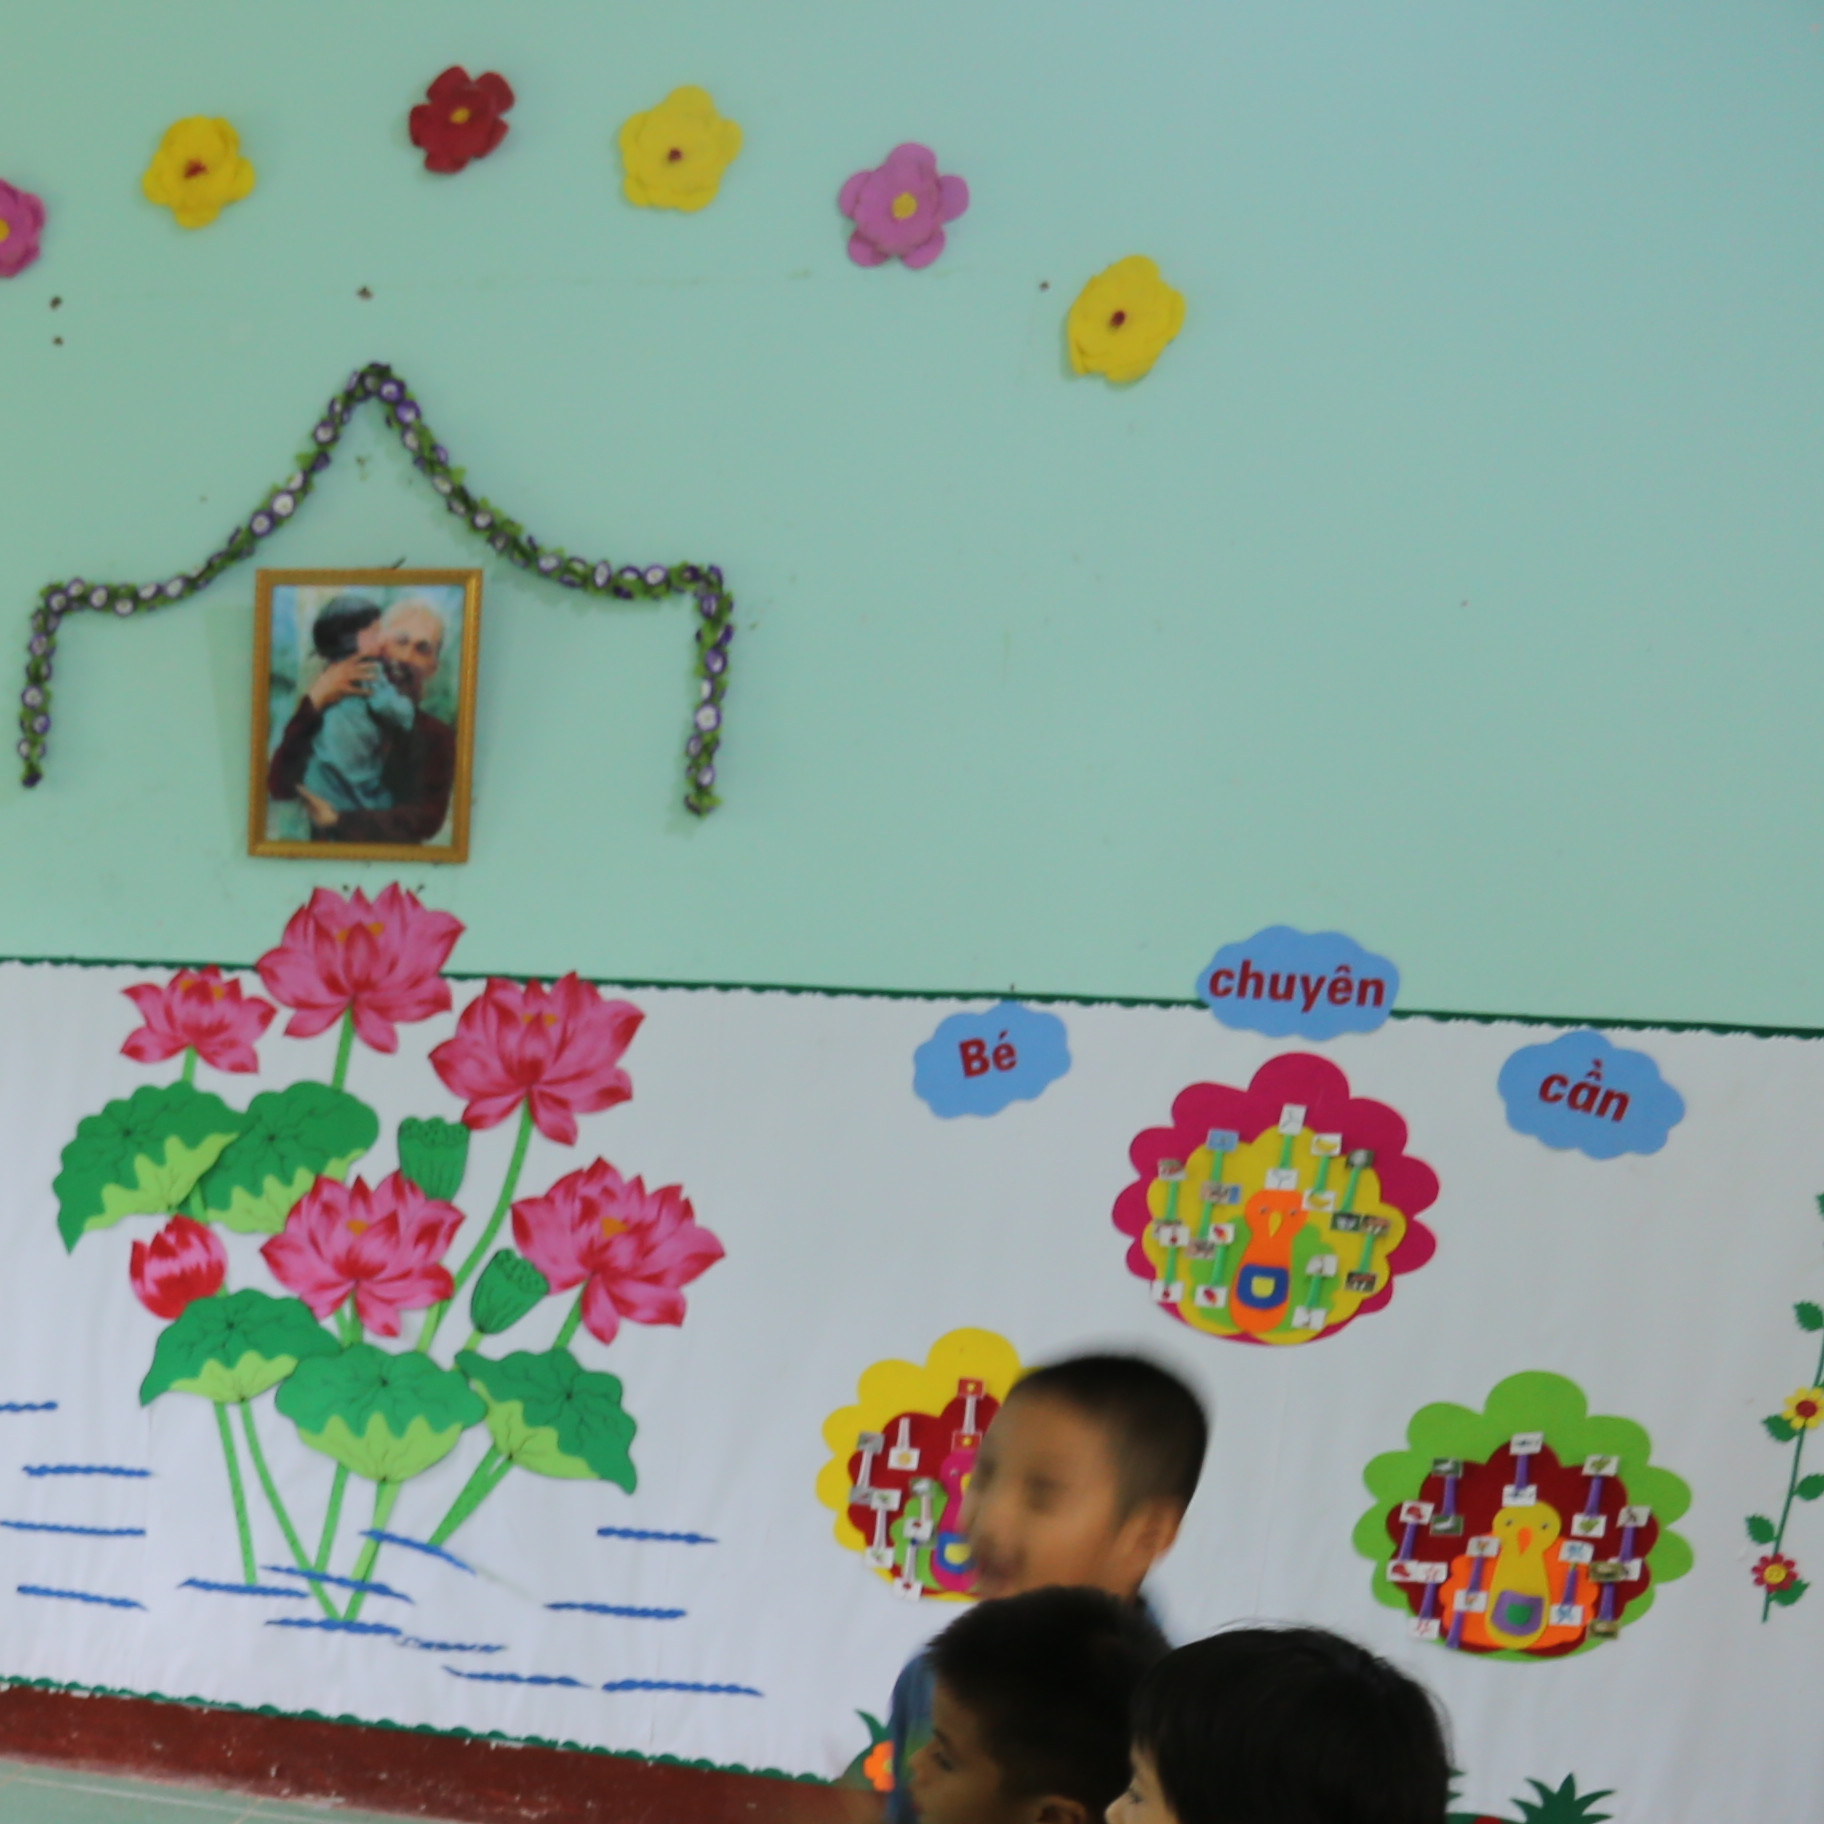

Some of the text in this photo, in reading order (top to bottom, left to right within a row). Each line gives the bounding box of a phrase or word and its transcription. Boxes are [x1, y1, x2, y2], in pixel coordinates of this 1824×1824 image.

[958, 959, 1631, 1123] Bé chuyên cần
